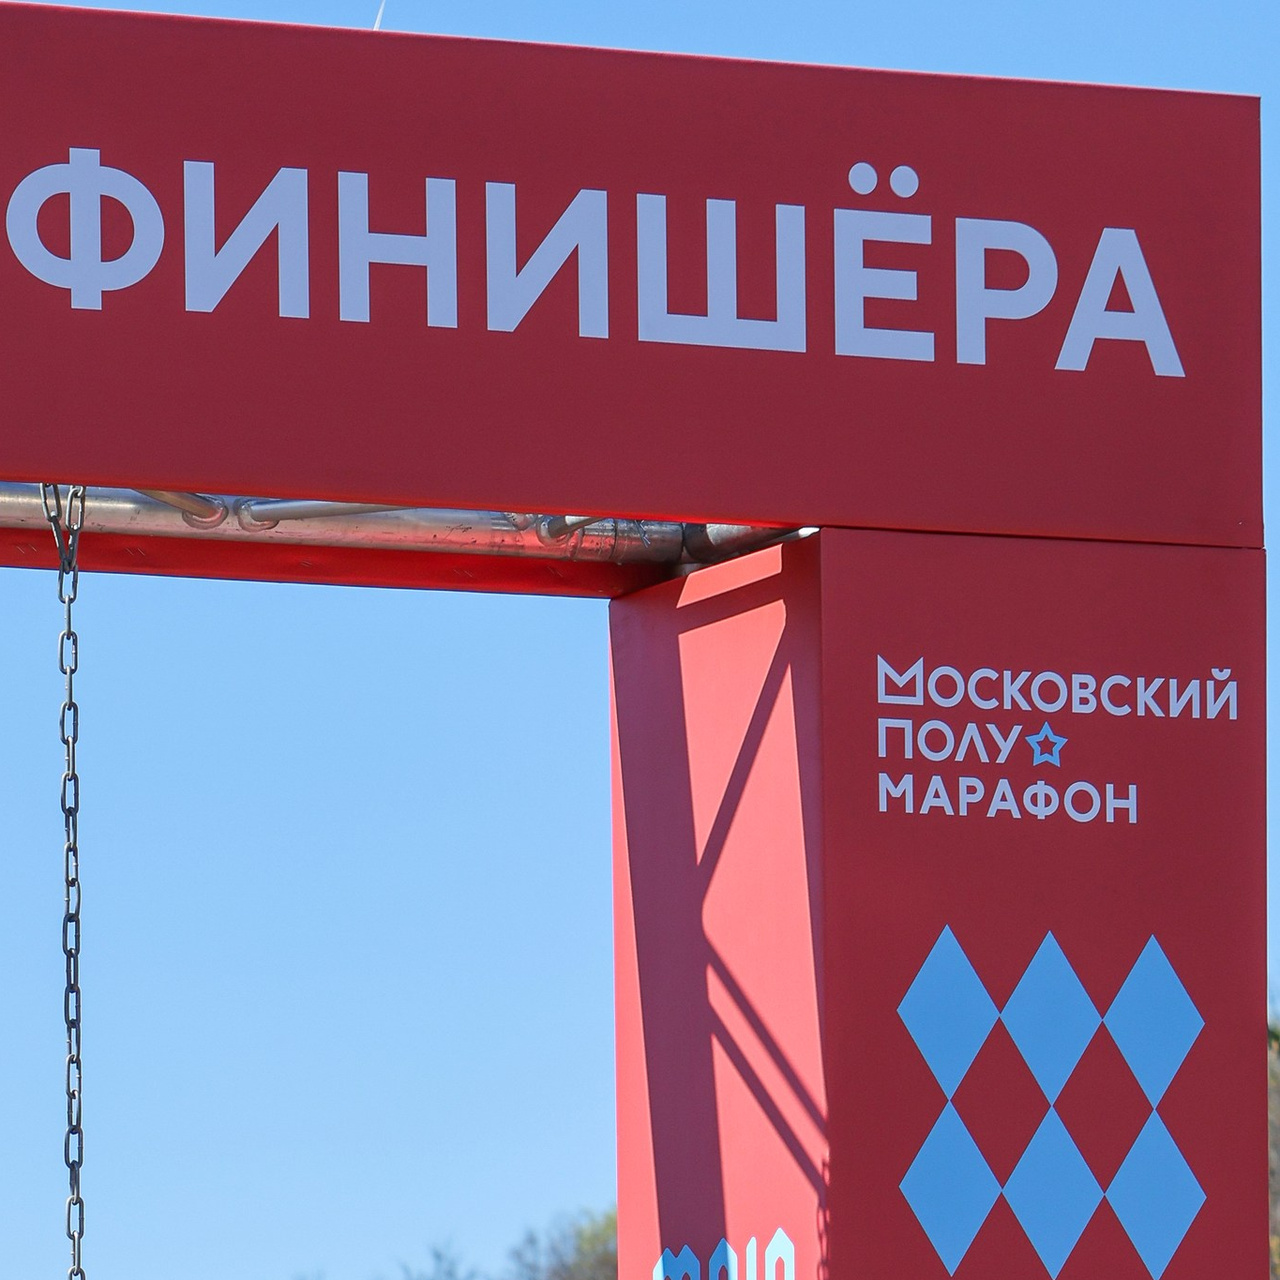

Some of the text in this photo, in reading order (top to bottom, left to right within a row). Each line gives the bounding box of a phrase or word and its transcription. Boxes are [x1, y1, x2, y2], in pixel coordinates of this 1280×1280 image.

[6, 148, 1186, 377] ФИНИШЁРА
[878, 655, 1238, 721] МОСКОВСКИЙ
[878, 718, 1020, 765] ПОЛУ
[878, 773, 1138, 824] МАРАФОН
